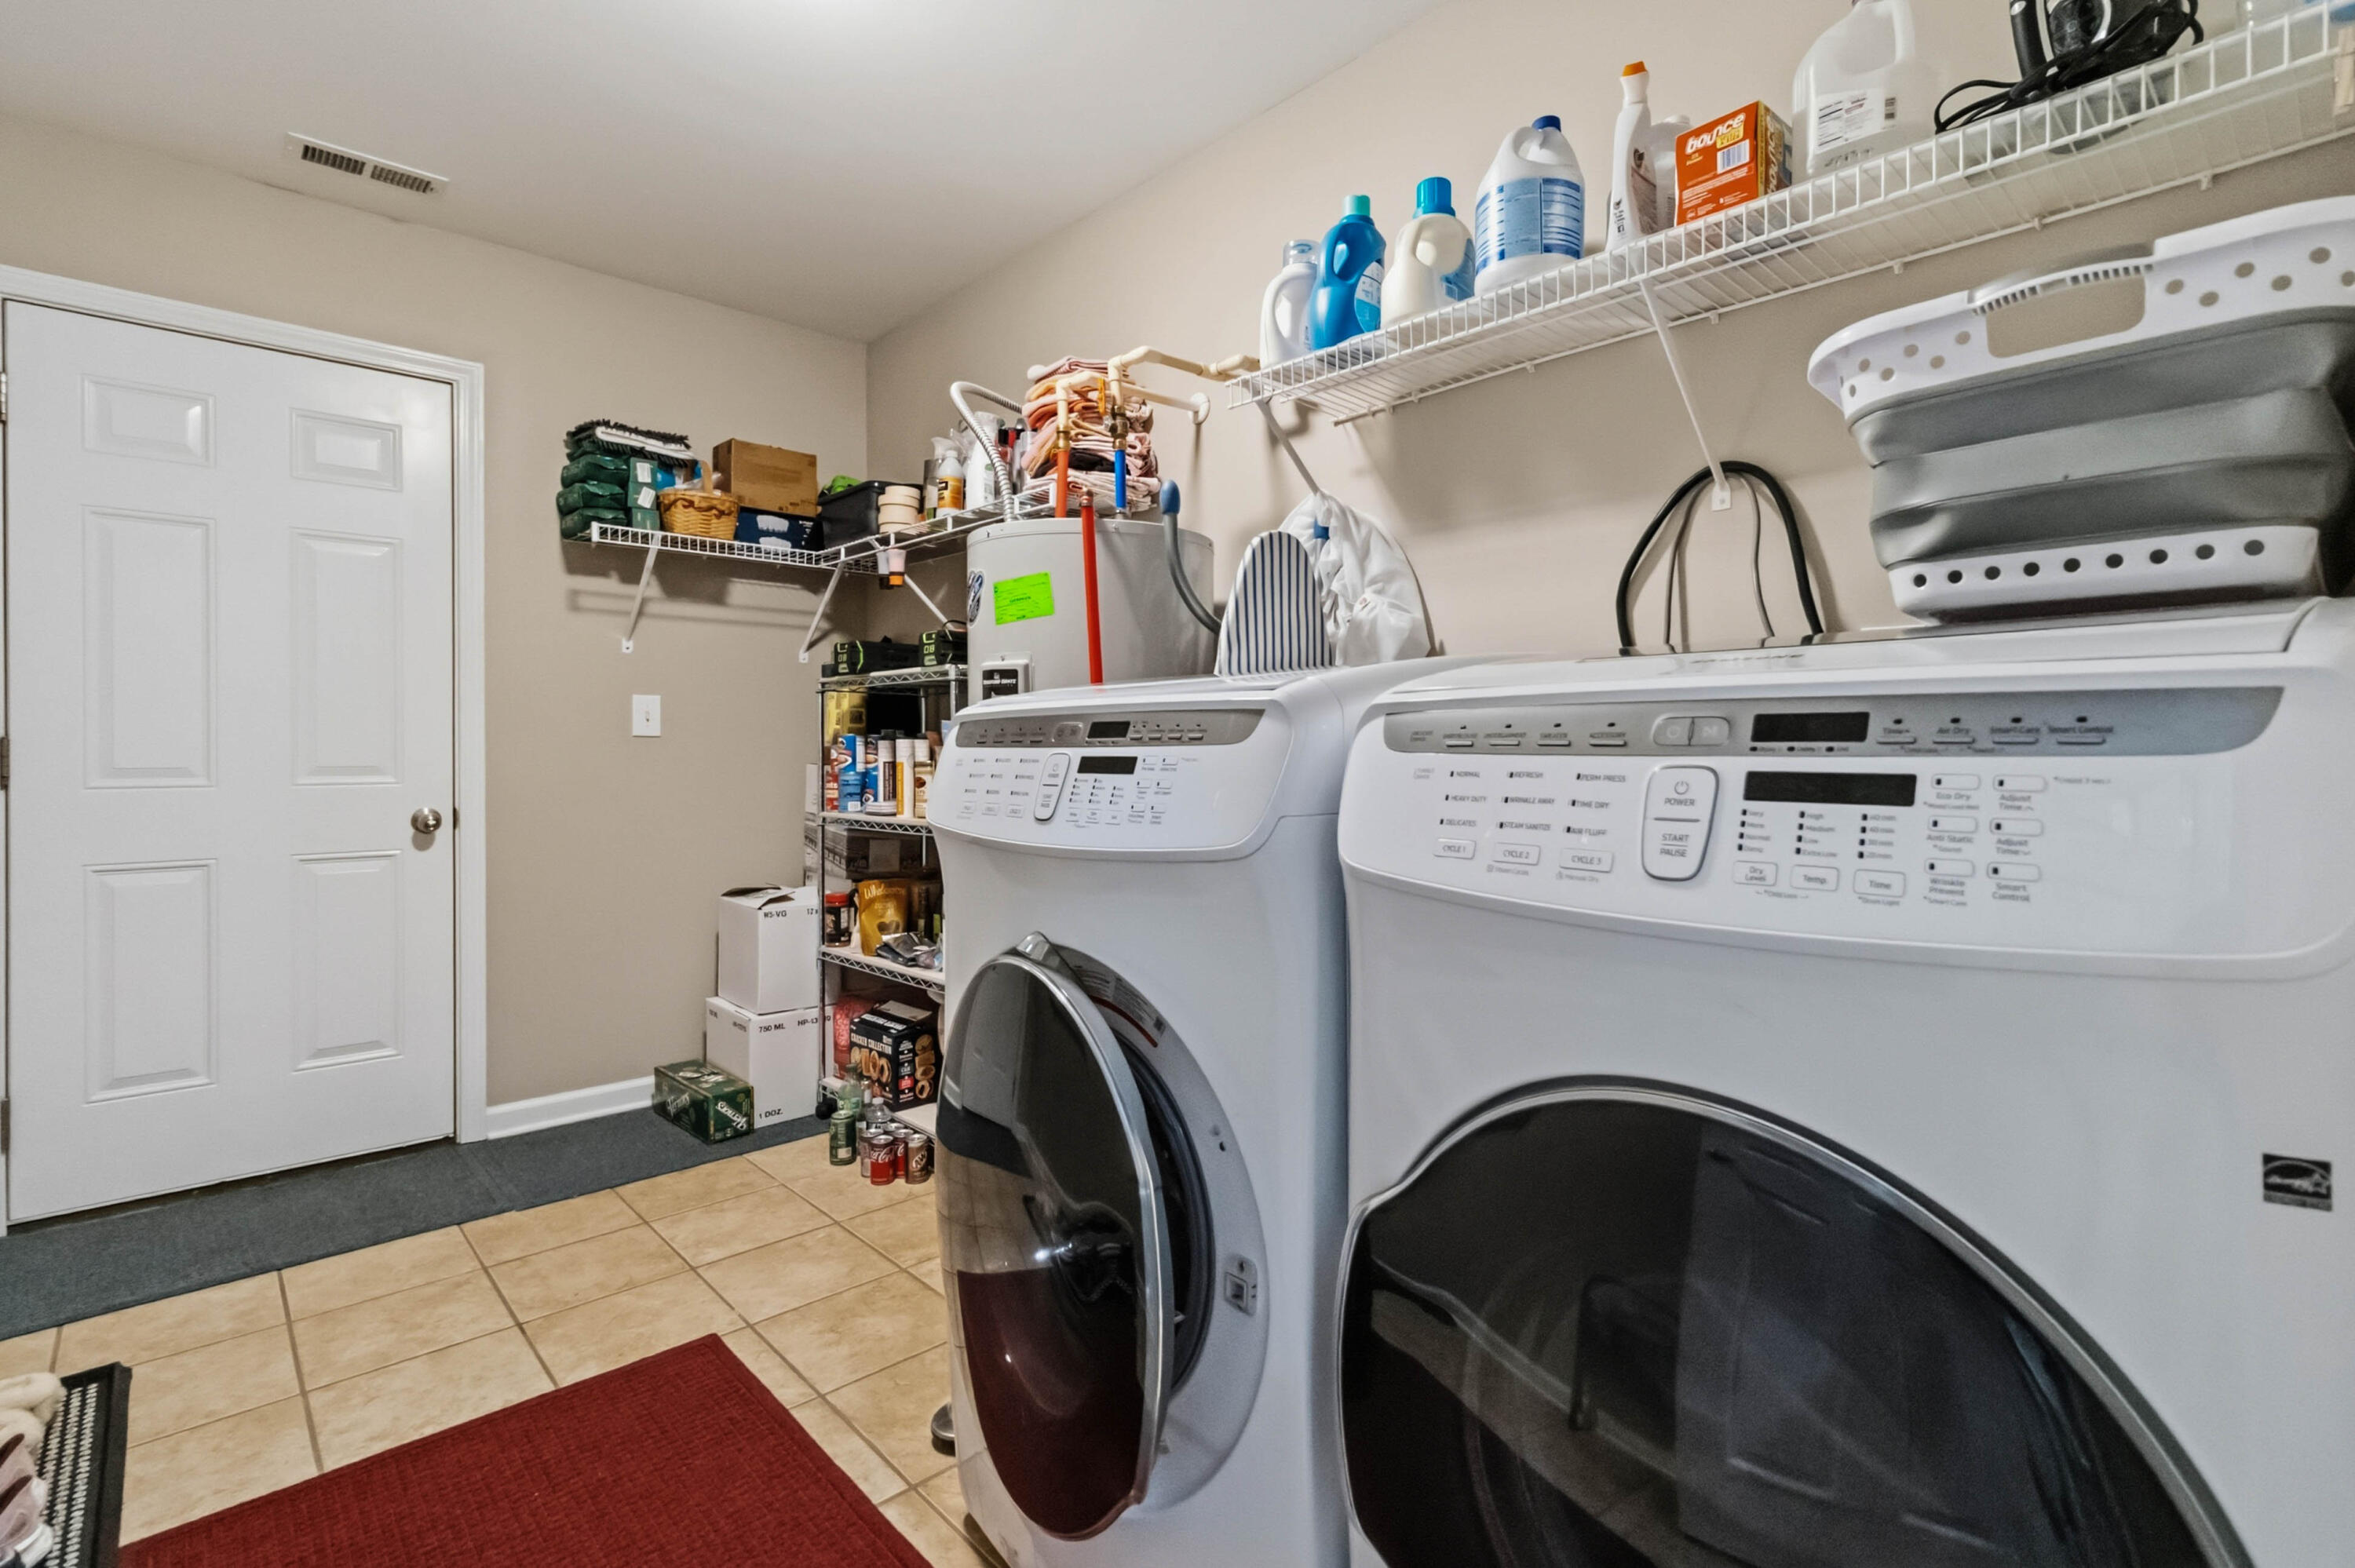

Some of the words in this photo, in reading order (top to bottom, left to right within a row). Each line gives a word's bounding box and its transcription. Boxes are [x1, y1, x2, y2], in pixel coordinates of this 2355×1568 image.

[1685, 112, 1746, 155] bounce
[1664, 797, 1696, 807] POWER
[1954, 793, 1971, 801] Dry
[1575, 799, 1594, 808] TIME
[1594, 800, 1609, 809] DRY
[1662, 833, 1690, 842] START
[1948, 835, 1974, 844] Static
[1442, 844, 1461, 853] CYCLE
[1659, 848, 1688, 858] PAUSE
[1502, 849, 1524, 859] CYCLE
[1571, 855, 1595, 864] CYCLE
[1749, 866, 1763, 875] Dry
[1744, 873, 1766, 882] Level
[1803, 874, 1827, 885] Temp
[1930, 877, 1966, 887] Wrinkle
[1869, 880, 1892, 890] Time
[1995, 882, 2027, 892] Smart
[1929, 886, 1965, 896] Prevent
[1992, 891, 2031, 903] Control
[758, 1025, 772, 1034] 750
[774, 1023, 786, 1031] ML
[716, 1101, 747, 1130] Vernors
[765, 1108, 783, 1118] DOZ.
